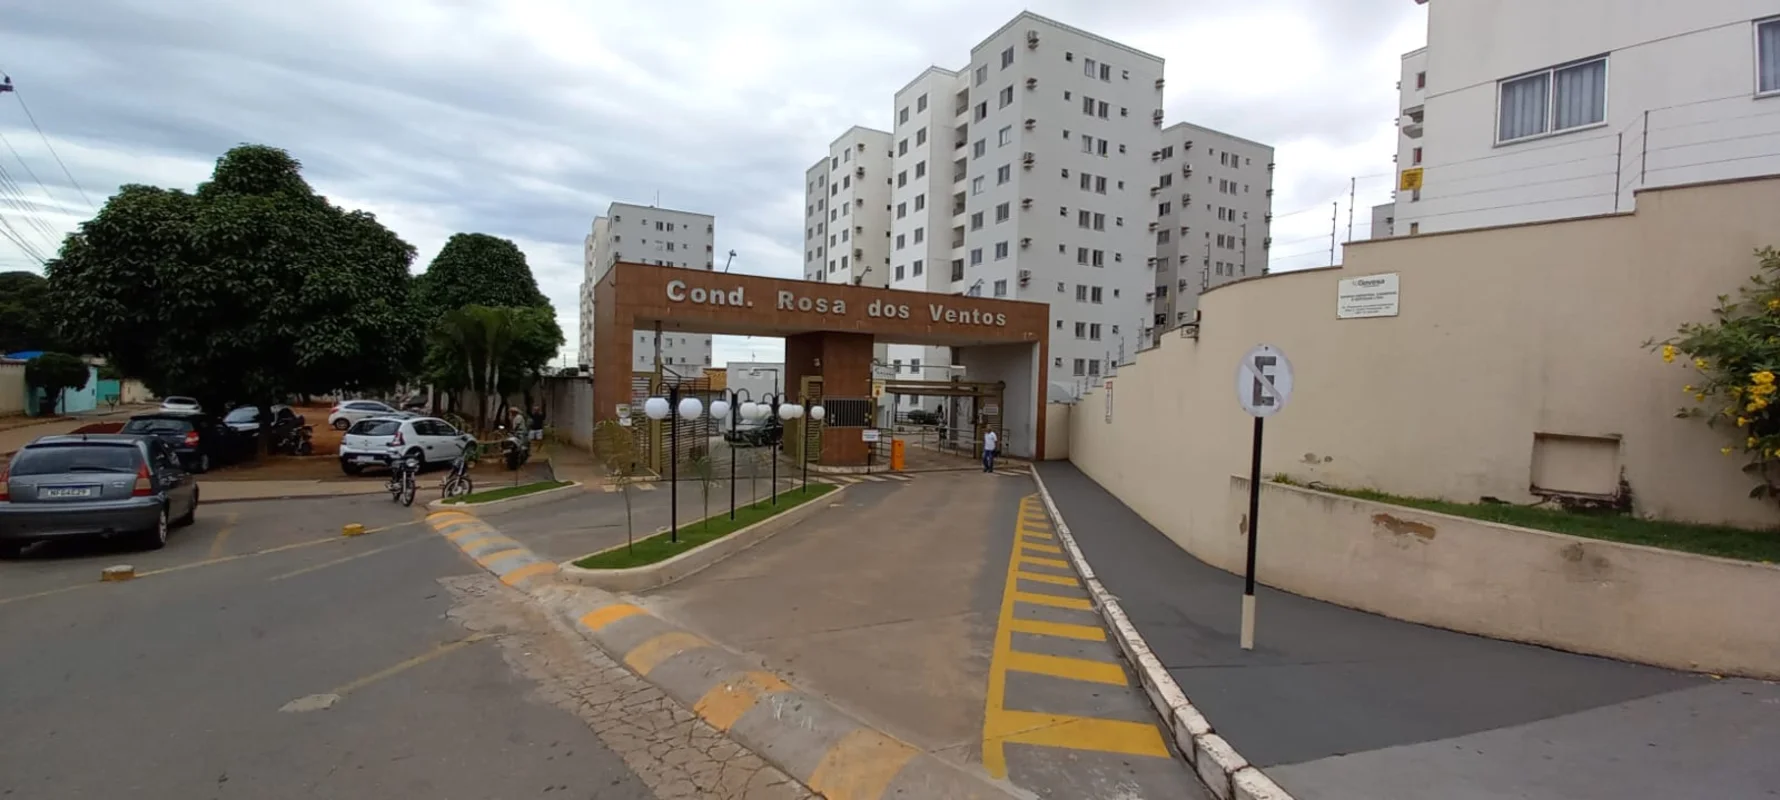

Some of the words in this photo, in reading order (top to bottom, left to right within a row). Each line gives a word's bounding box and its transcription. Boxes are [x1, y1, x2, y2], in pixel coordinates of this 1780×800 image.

[666, 279, 754, 309] Cond.
[776, 289, 847, 315] Rosa
[868, 298, 911, 320] dos
[928, 302, 1008, 327] Ventos
